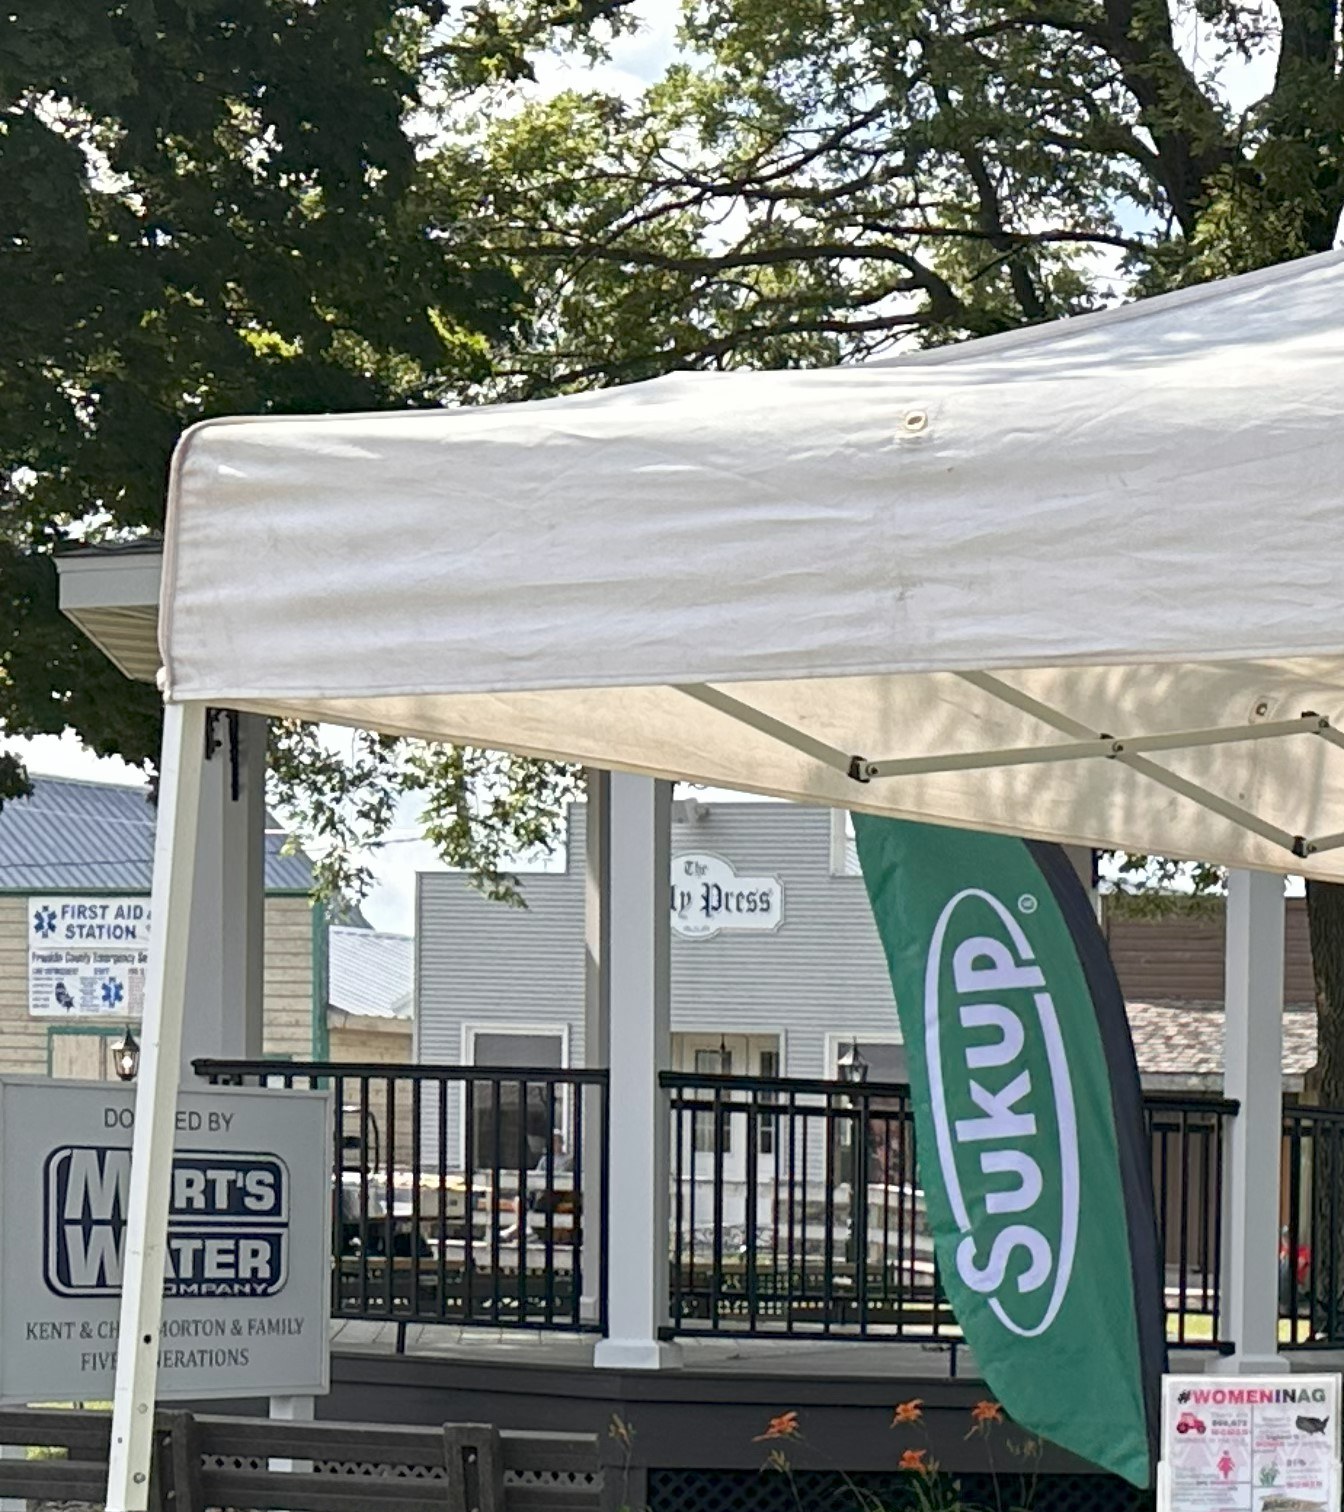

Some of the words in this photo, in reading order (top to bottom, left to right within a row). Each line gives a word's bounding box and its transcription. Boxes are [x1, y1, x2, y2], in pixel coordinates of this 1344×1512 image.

[700, 882, 773, 918] Press
[60, 905, 109, 920] FIRST
[114, 905, 143, 920] AID
[65, 923, 136, 940] STATION
[104, 1108, 201, 1131] DOED
[208, 1112, 234, 1131] BY
[953, 936, 1052, 1295] Sukup
[64, 1149, 275, 1220] MRT'S
[64, 1225, 271, 1287] WTER
[163, 1283, 269, 1296] OMPANY
[26, 1321, 76, 1341] KENT
[79, 1321, 93, 1339] &
[230, 1319, 244, 1338] &
[248, 1317, 304, 1337] FAMILY
[81, 1352, 117, 1372] FIVE
[156, 1349, 250, 1370] ERATIONS
